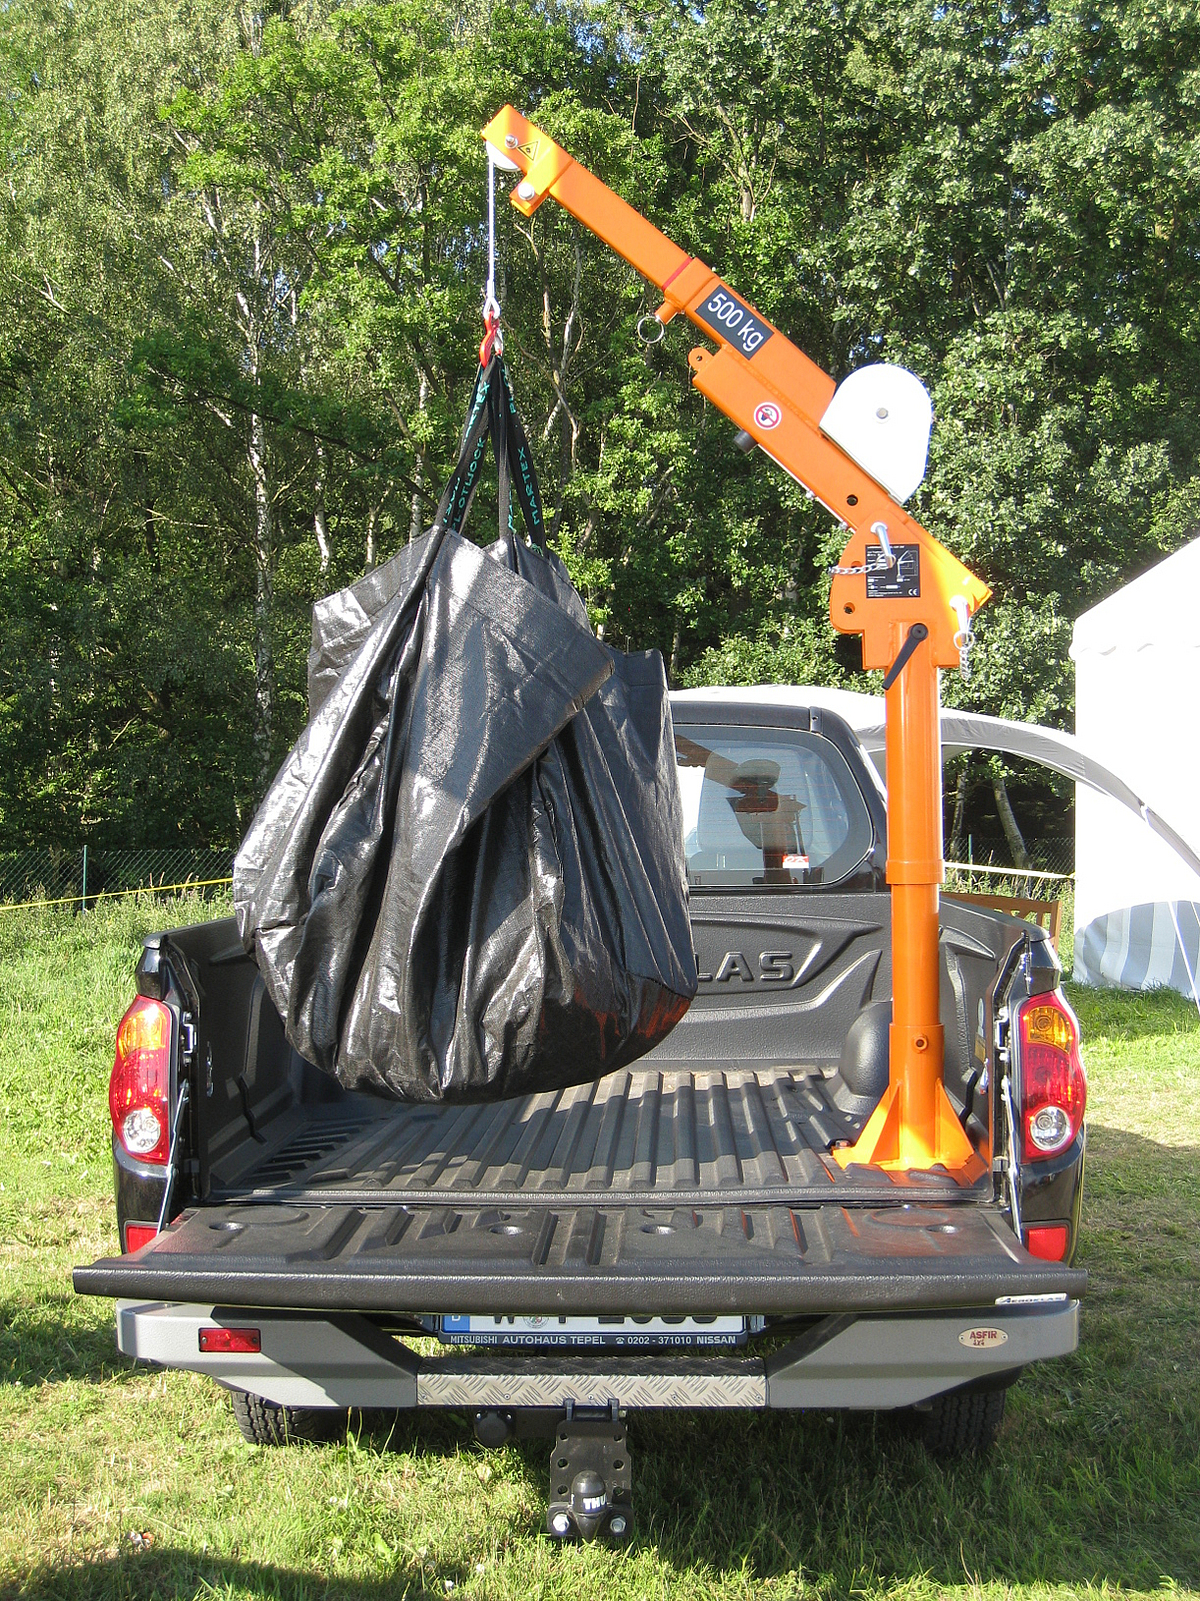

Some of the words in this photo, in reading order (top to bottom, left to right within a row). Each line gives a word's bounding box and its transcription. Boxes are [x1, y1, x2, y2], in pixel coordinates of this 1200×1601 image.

[707, 293, 744, 328] 500
[737, 319, 764, 352] kg
[517, 446, 540, 525] MARTEX
[450, 1335, 498, 1344] MITSUBISHI
[502, 1335, 567, 1345] AUTOHAUS
[570, 1335, 606, 1344] TEPEL
[627, 1336, 650, 1344] 0202
[658, 1336, 692, 1344] 371010
[696, 1335, 736, 1344] NISSAN
[969, 1330, 998, 1340] ASFIR
